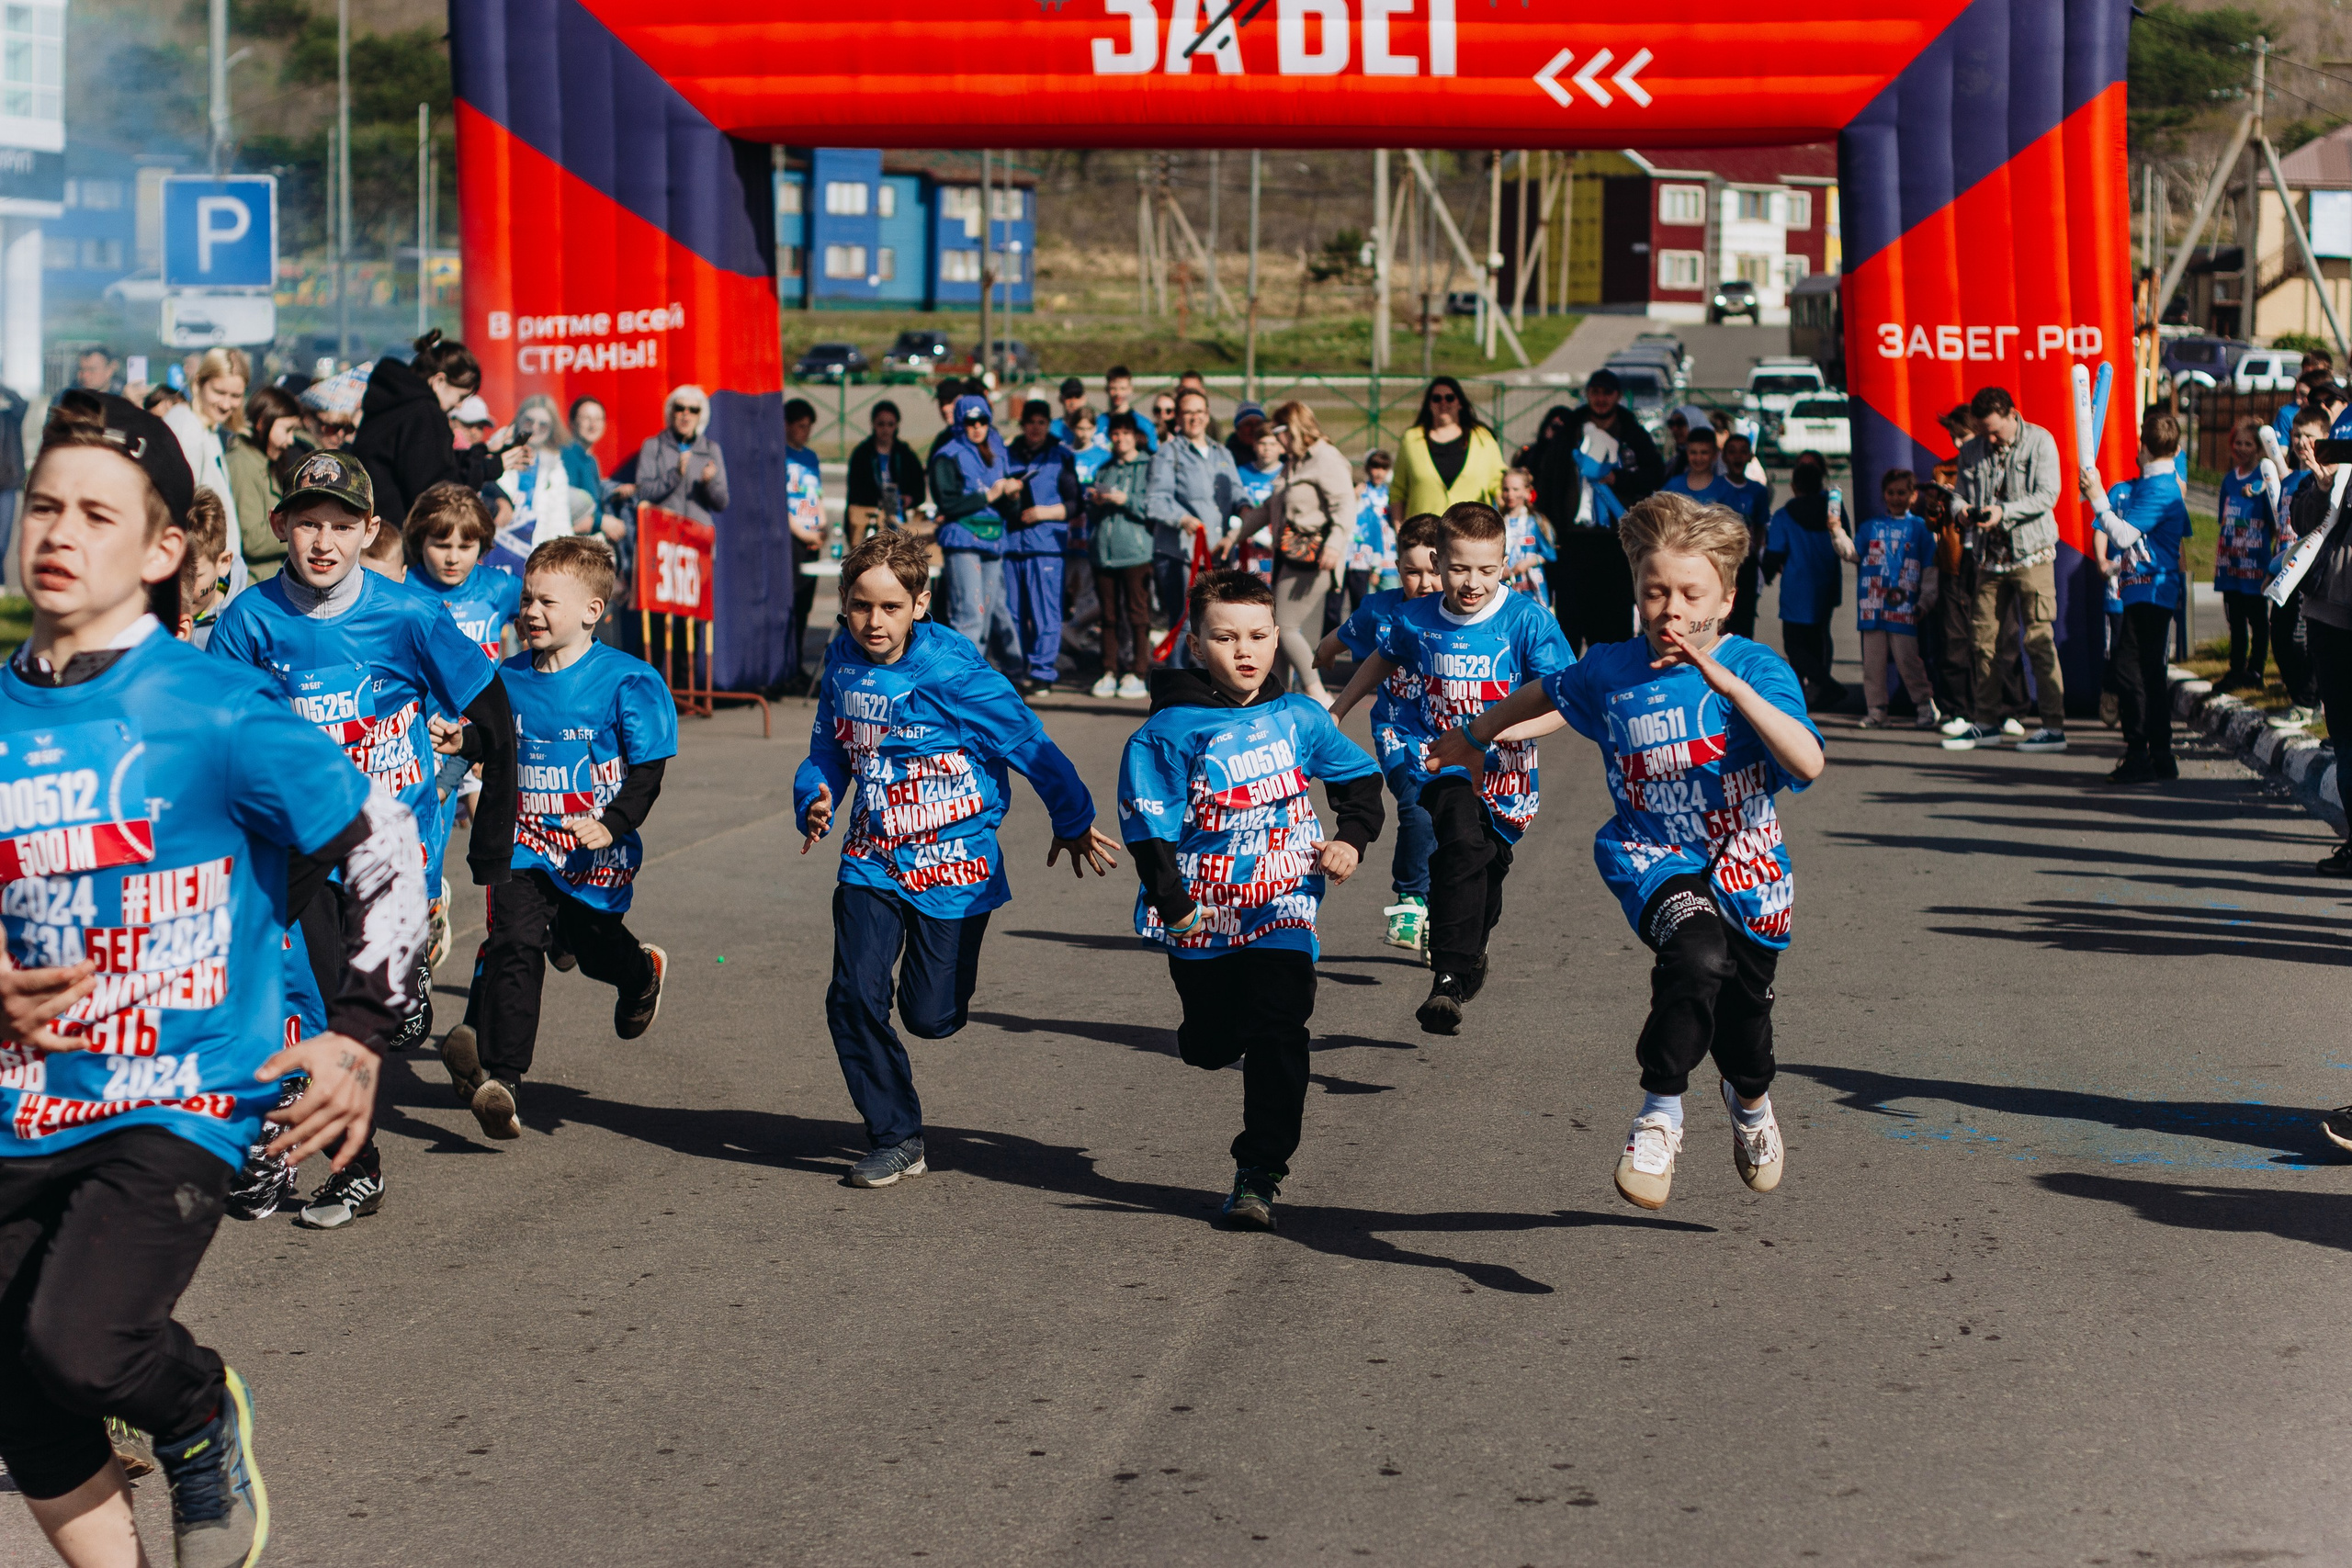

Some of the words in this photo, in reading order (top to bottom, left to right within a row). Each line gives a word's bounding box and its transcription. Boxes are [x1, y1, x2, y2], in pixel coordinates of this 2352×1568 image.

[196, 197, 251, 273] P
[488, 310, 511, 340] В
[517, 312, 611, 343] ритме
[616, 301, 684, 334] всей
[517, 338, 658, 374] СТРАНЫ!
[1877, 322, 2103, 361] ЗАБЕГ.РФ
[843, 667, 856, 675] ПСБ
[1434, 651, 1491, 679] 00523
[843, 690, 888, 723] 00522
[1216, 732, 1234, 743] ПСБ
[1627, 705, 1688, 748] 00511
[517, 762, 570, 791] 00501
[1227, 739, 1295, 783] 00518
[865, 769, 978, 812] ЗАБЕГ2024
[1133, 797, 1165, 816] ПСБ
[881, 792, 984, 837] #МОМЕНТ
[911, 838, 967, 869] 2024
[1176, 852, 1236, 883] ЗАБЕГ
[1272, 894, 1317, 922] 2024
[103, 1053, 201, 1101] 2024
